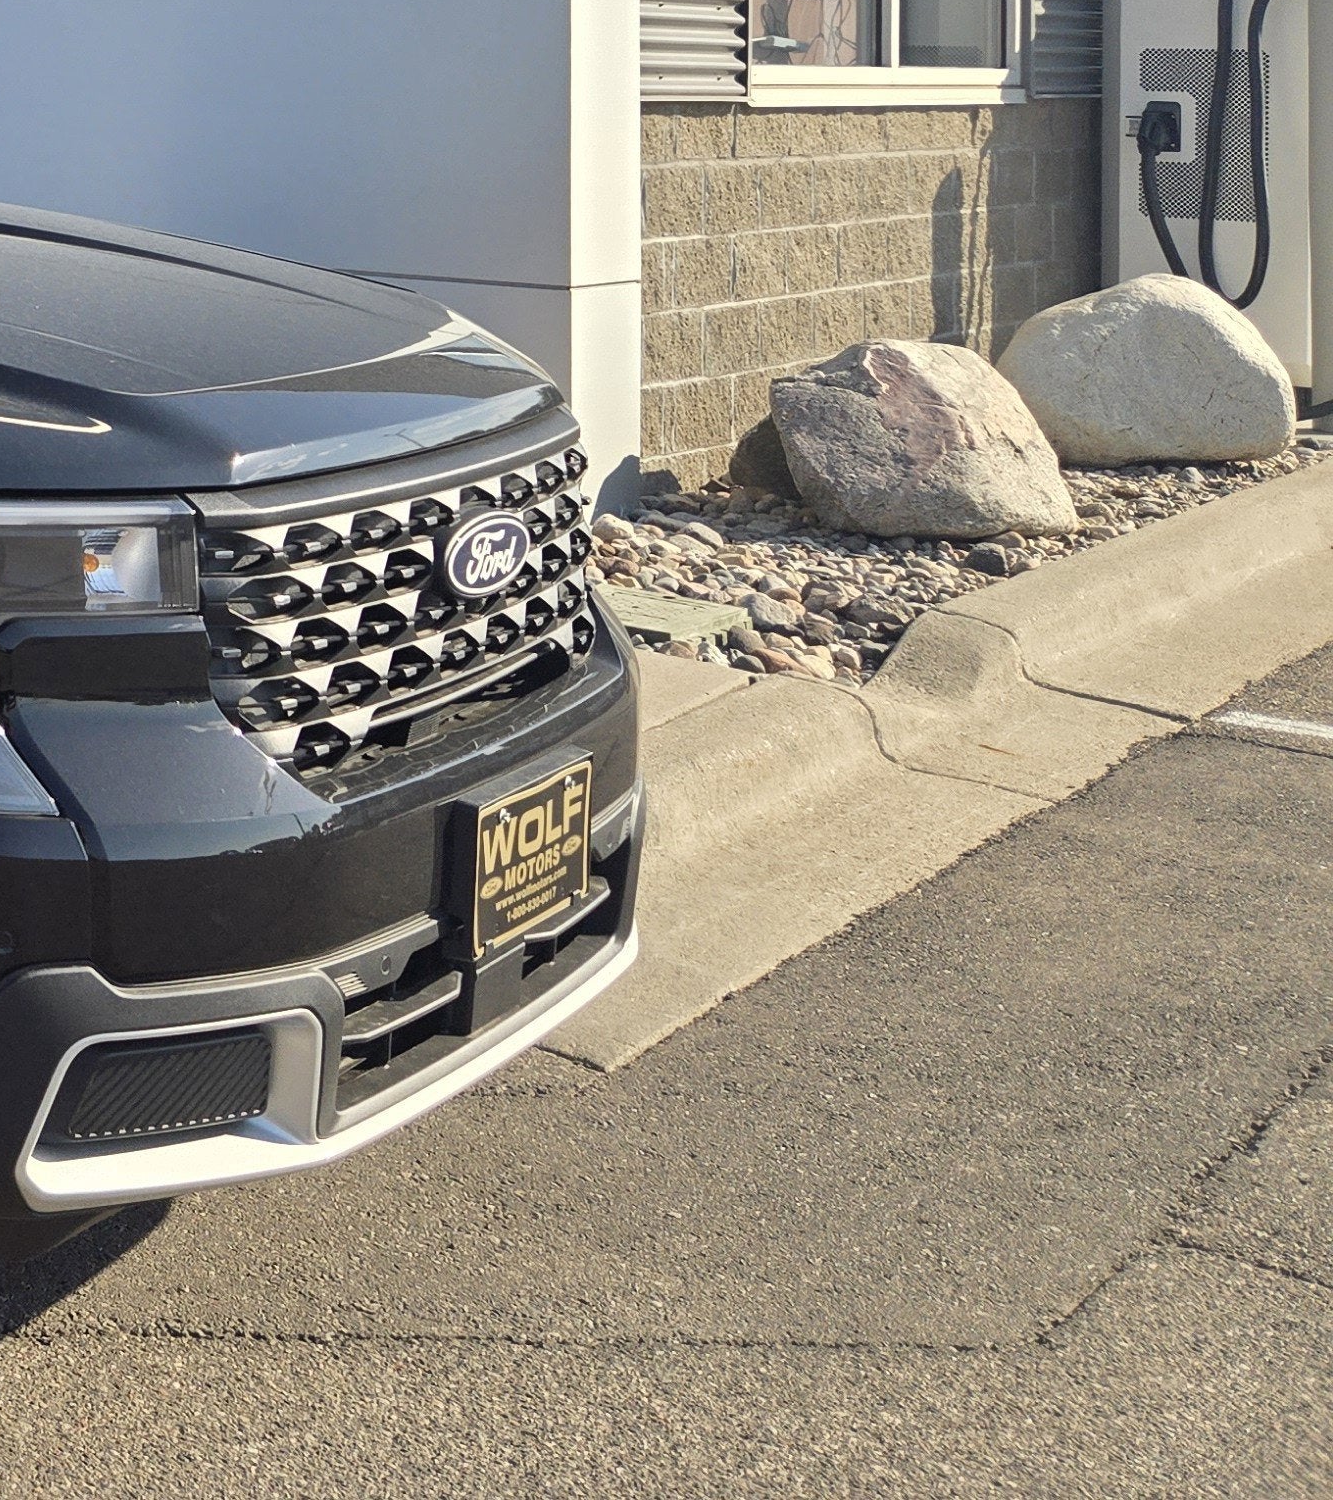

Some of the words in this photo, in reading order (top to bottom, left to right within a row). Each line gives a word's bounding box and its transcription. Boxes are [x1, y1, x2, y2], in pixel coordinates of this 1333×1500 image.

[465, 529, 518, 585] Ford
[483, 782, 584, 876] WOLF
[504, 843, 561, 892] MOTORS
